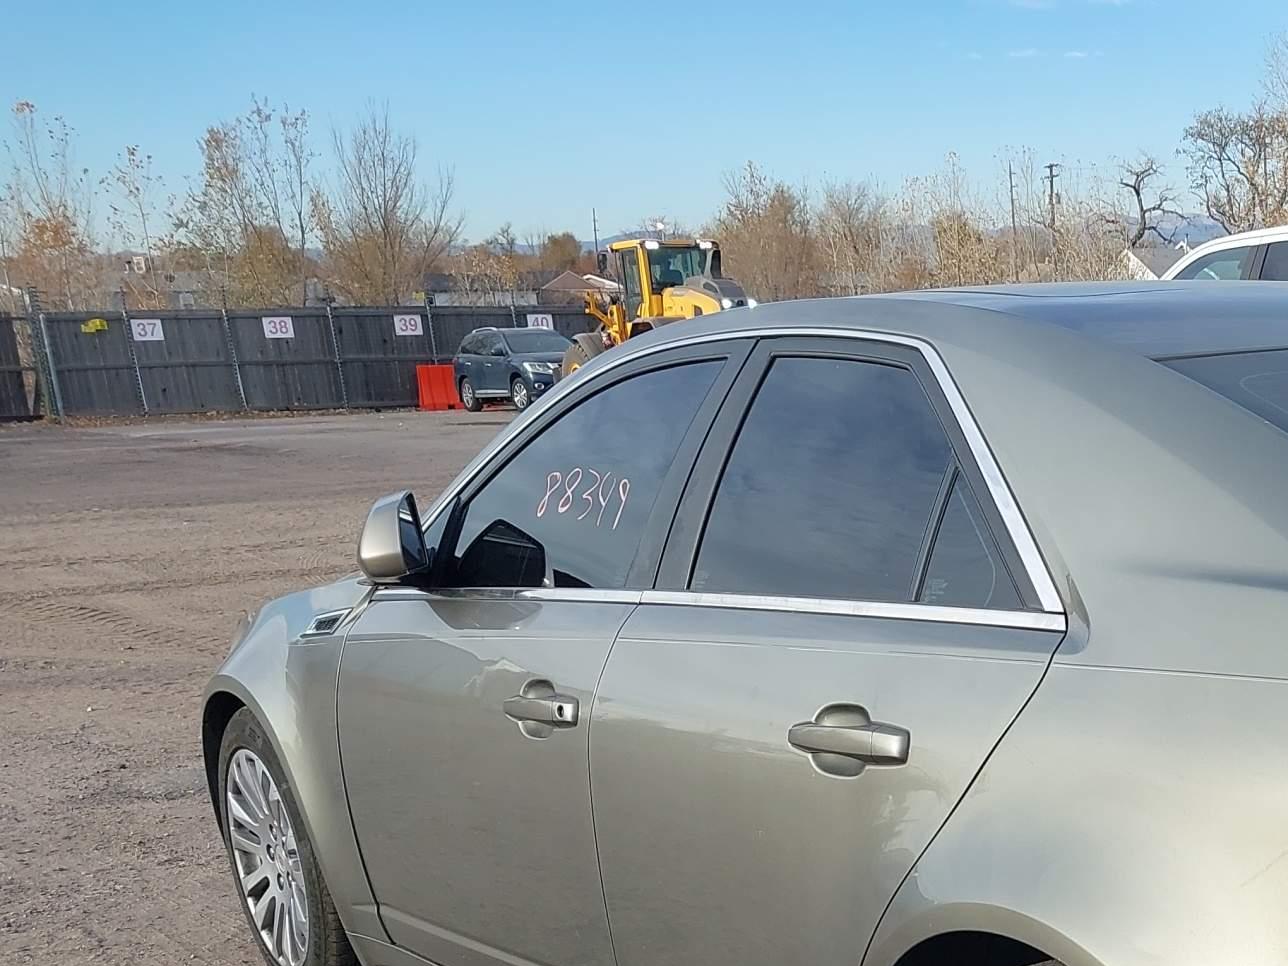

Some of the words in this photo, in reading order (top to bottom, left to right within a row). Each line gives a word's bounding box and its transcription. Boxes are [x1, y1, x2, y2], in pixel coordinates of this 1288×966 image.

[136, 322, 157, 337] 37
[267, 319, 289, 335] 38
[399, 317, 418, 332] 39
[532, 316, 549, 328] 40
[536, 467, 631, 530] 88349
